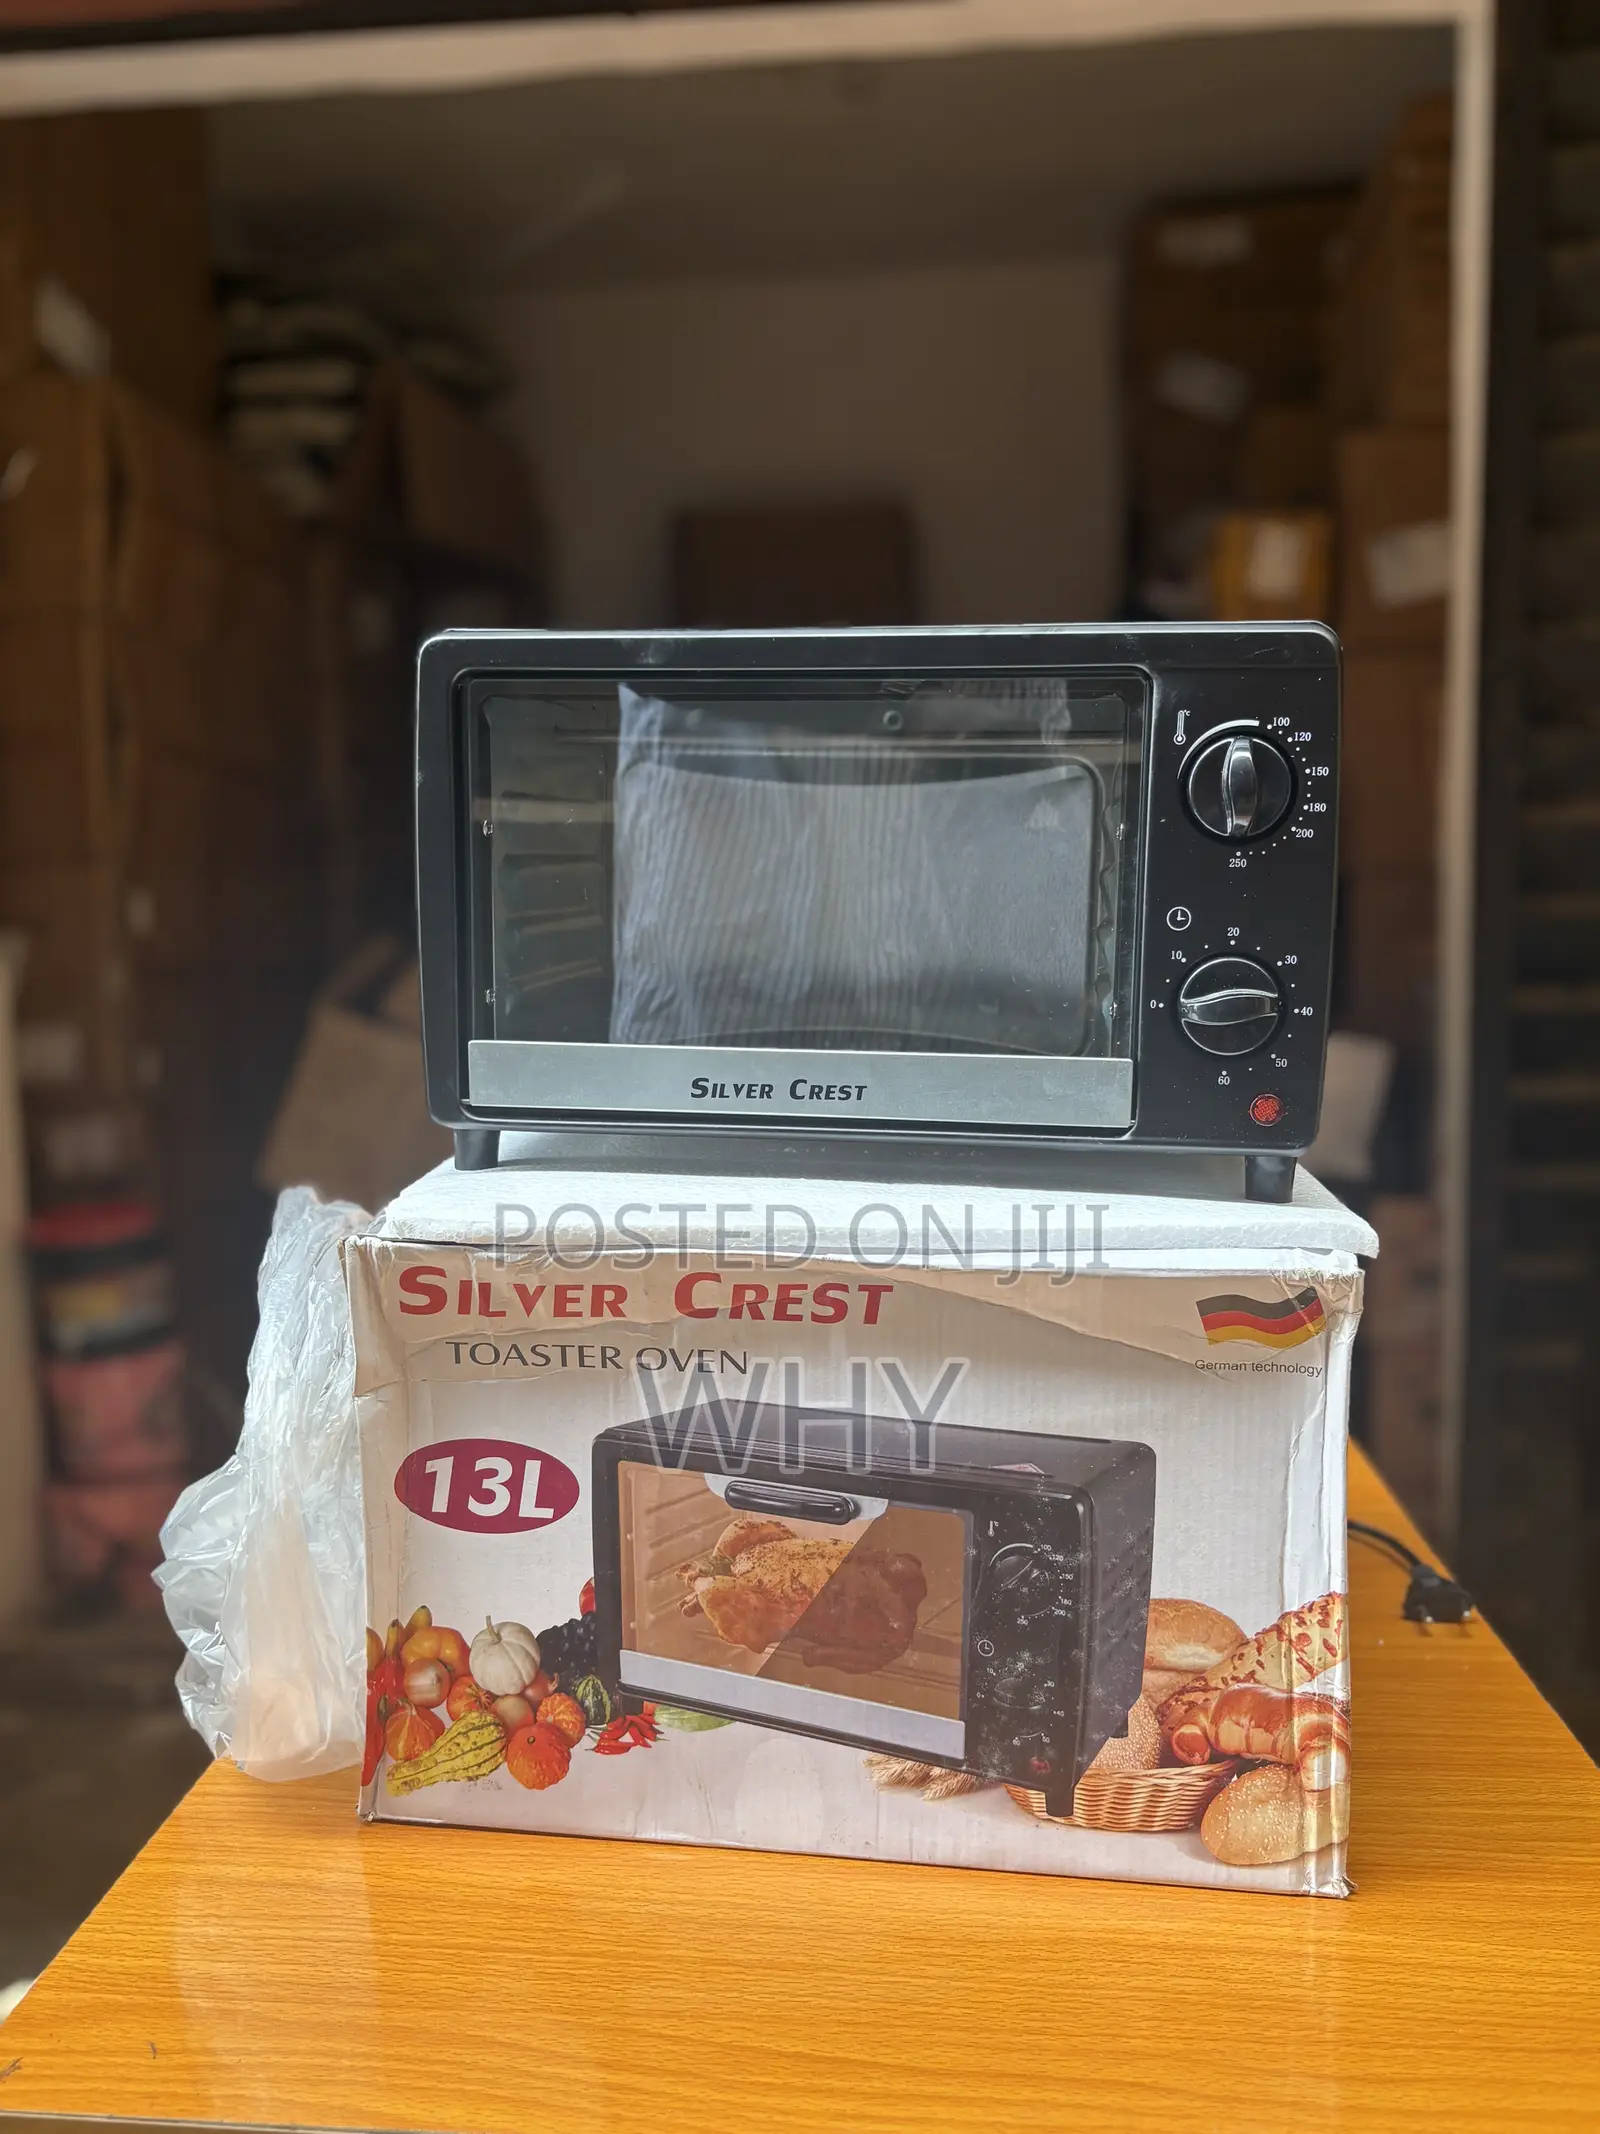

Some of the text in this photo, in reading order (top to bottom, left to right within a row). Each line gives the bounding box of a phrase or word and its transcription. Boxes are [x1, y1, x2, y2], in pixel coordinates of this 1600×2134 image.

[1272, 717, 1290, 727] 100
[1294, 732, 1312, 742] 120
[1311, 766, 1329, 776] 150
[1308, 803, 1327, 812] 180
[1295, 828, 1314, 838] 200
[1229, 858, 1247, 868] 250
[1227, 927, 1240, 937] 20
[1170, 950, 1182, 960] 10
[1285, 955, 1297, 965] 30
[1150, 999, 1157, 1009] 0
[1300, 1007, 1313, 1016] 40
[1275, 1058, 1288, 1068] 50
[1218, 1076, 1230, 1086] 60
[690, 1077, 867, 1101] SILVER CREST
[398, 1265, 894, 1325] SILVER CREST
[445, 1341, 749, 1375] TOASTER OVEN
[1194, 1360, 1323, 1378] German technology
[424, 1456, 557, 1519] 13L
